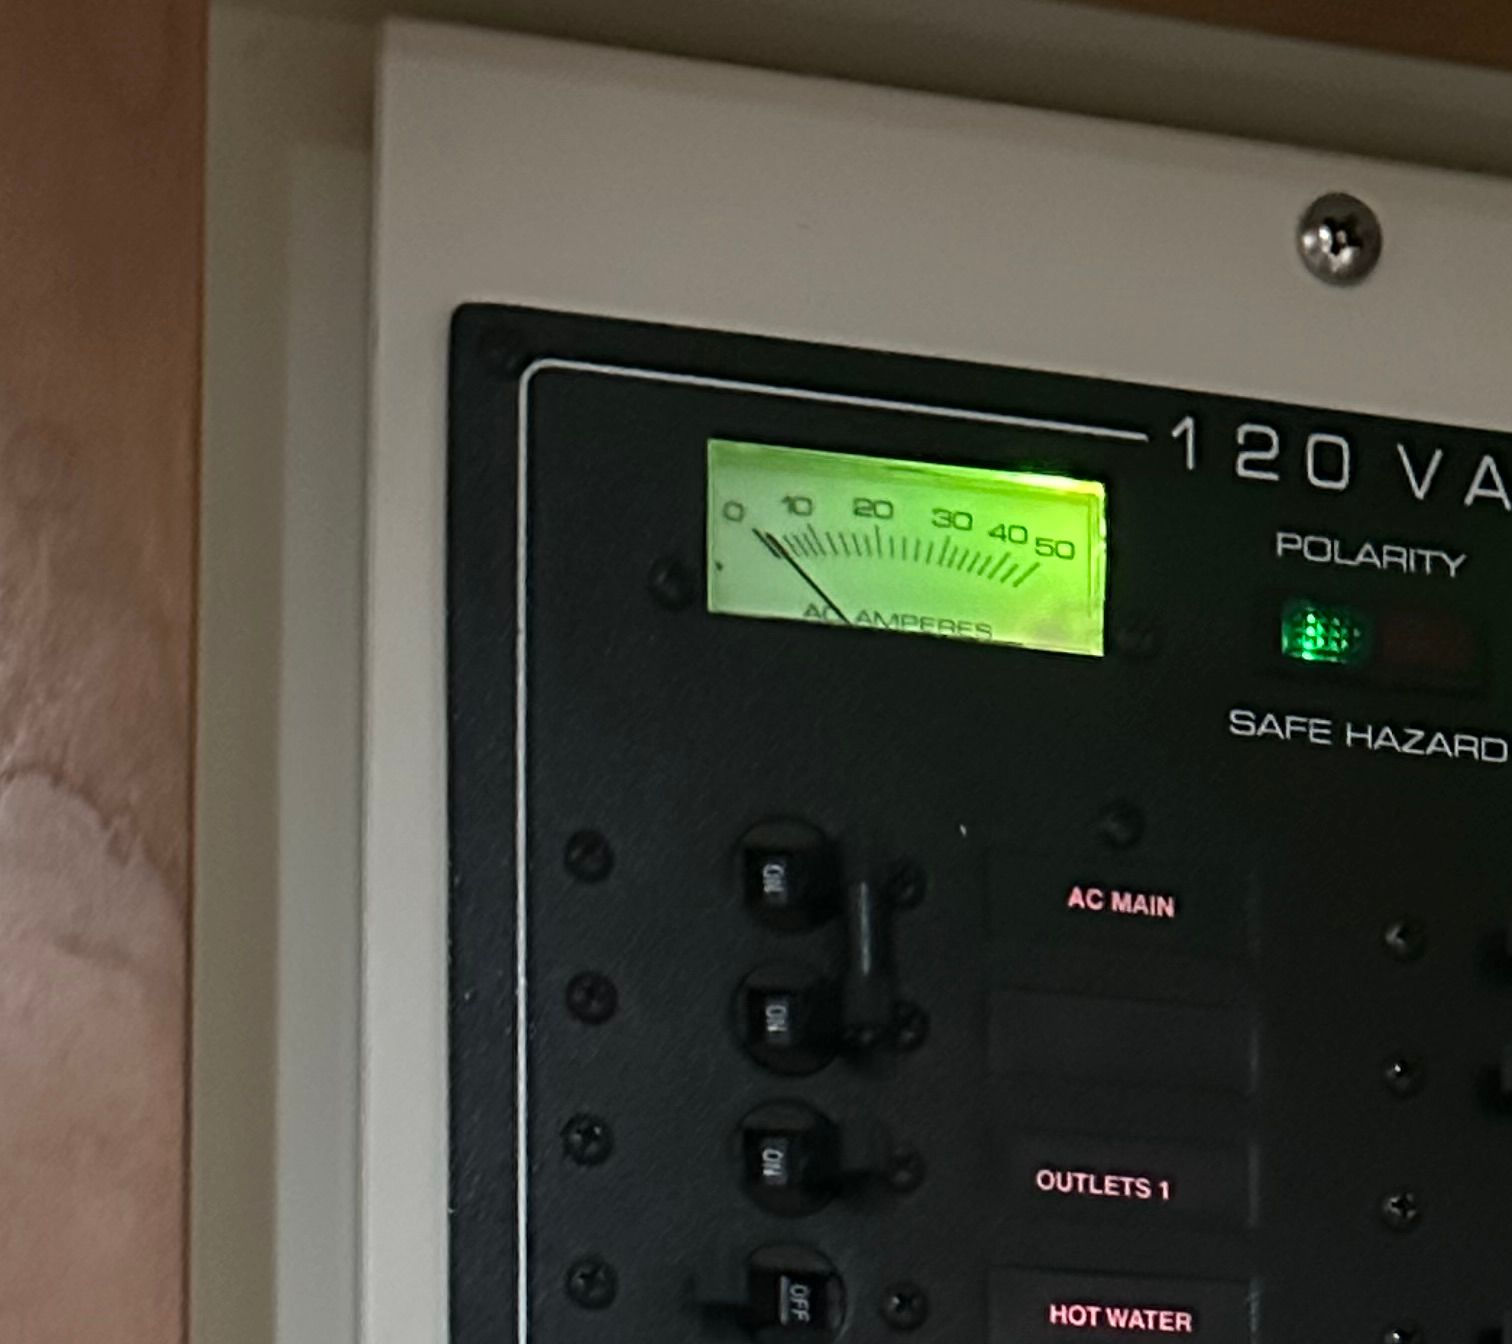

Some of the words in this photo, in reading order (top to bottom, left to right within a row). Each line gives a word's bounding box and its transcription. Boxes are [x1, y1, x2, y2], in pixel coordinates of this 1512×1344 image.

[1171, 416, 1350, 491] 120
[722, 500, 744, 522] 0
[781, 496, 814, 517] 10
[853, 498, 895, 520] 20
[932, 508, 974, 532] 30
[989, 524, 1029, 545] 40
[1035, 536, 1076, 561] 50
[1276, 531, 1466, 578] POLARITY
[1229, 709, 1332, 745] SAFE
[1346, 722, 1509, 763] HAZARD
[1067, 886, 1104, 911] AC
[1111, 890, 1175, 918] MAIN
[1035, 1169, 1152, 1199] OUTLETS
[1158, 1180, 1169, 1201] 1
[788, 1283, 811, 1323] OFF
[1049, 1303, 1102, 1327] HOT
[1104, 1306, 1192, 1333] WATER
